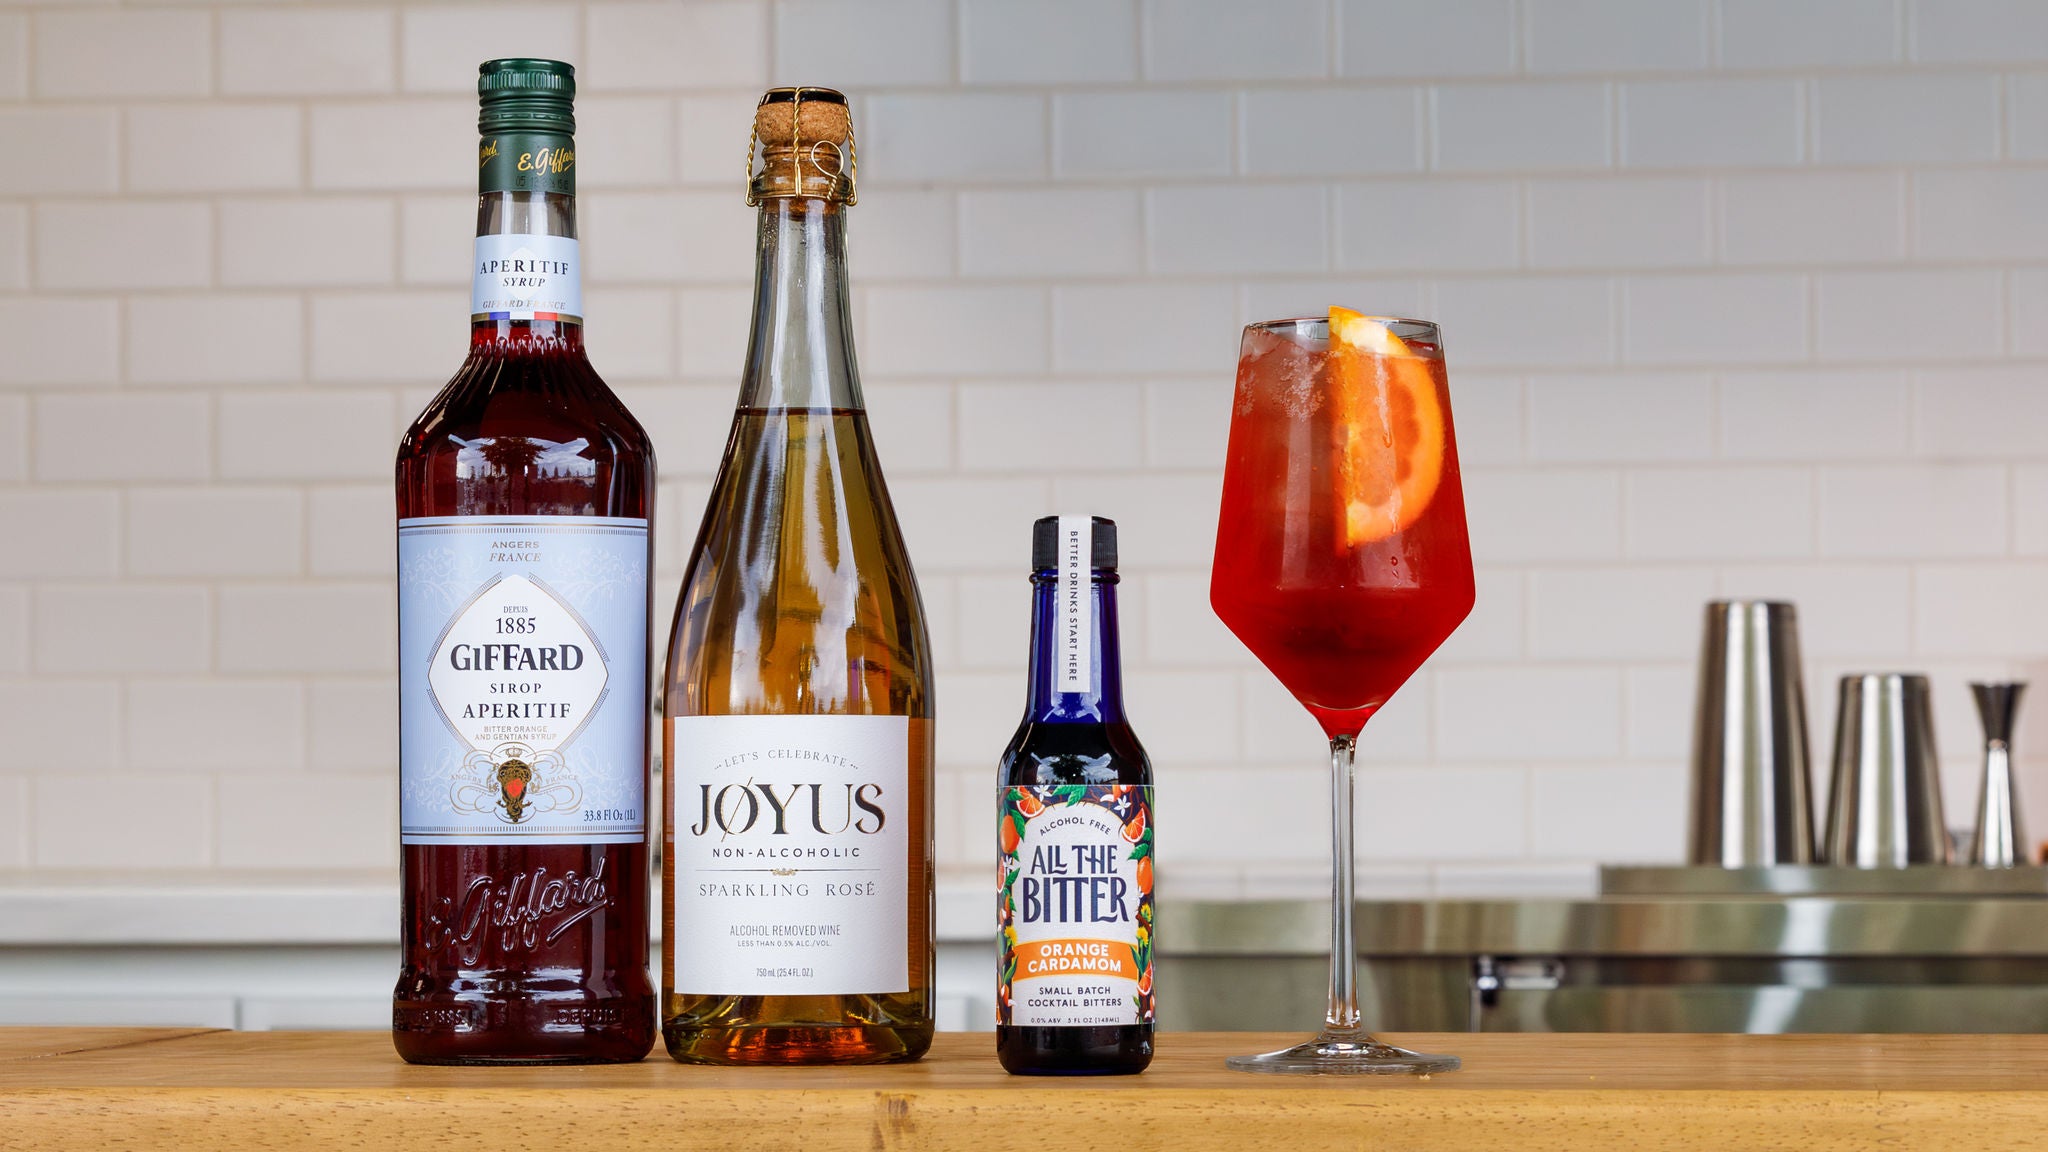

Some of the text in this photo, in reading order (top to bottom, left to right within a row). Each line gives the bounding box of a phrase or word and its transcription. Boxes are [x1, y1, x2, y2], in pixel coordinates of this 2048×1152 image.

[480, 259, 569, 275] APERITIF
[502, 277, 546, 287] SYRUP
[482, 299, 524, 309] GIFFARD
[491, 541, 540, 549] ANGERS
[489, 552, 541, 562] FRANCE
[503, 605, 529, 614] DEPUIS
[1068, 530, 1079, 681] BETTER DRINKS START HERE
[495, 616, 536, 634] 1885
[450, 643, 584, 671] GIFFARD
[489, 682, 542, 694] SIROP
[462, 703, 571, 719] APERITIF
[483, 725, 548, 733] BITTER ORANGE
[475, 733, 558, 741] AND GENTIAN SYRUP
[724, 749, 847, 767] LET'S CELEBRATE
[583, 809, 602, 822] 33.8
[612, 808, 623, 821] Oz
[691, 776, 887, 843] JØYUS
[1039, 816, 1111, 836] ALCOHOL FREE
[712, 848, 861, 858] NON-ALCOHOLIC
[1030, 845, 1118, 875] ALL THE
[699, 880, 876, 897] SPARKLING ROSÉ
[1023, 876, 1130, 923] BITTER
[730, 924, 841, 936] ALCOHOL REMOVED WINE
[1040, 943, 1109, 957] ORANGE
[1028, 957, 1121, 973] CARDAMOM
[756, 968, 767, 977] 750
[776, 968, 792, 978] (25.4
[1039, 986, 1111, 995] SMALL BATCH
[1028, 998, 1122, 1008] COCKTAIL BITTERS
